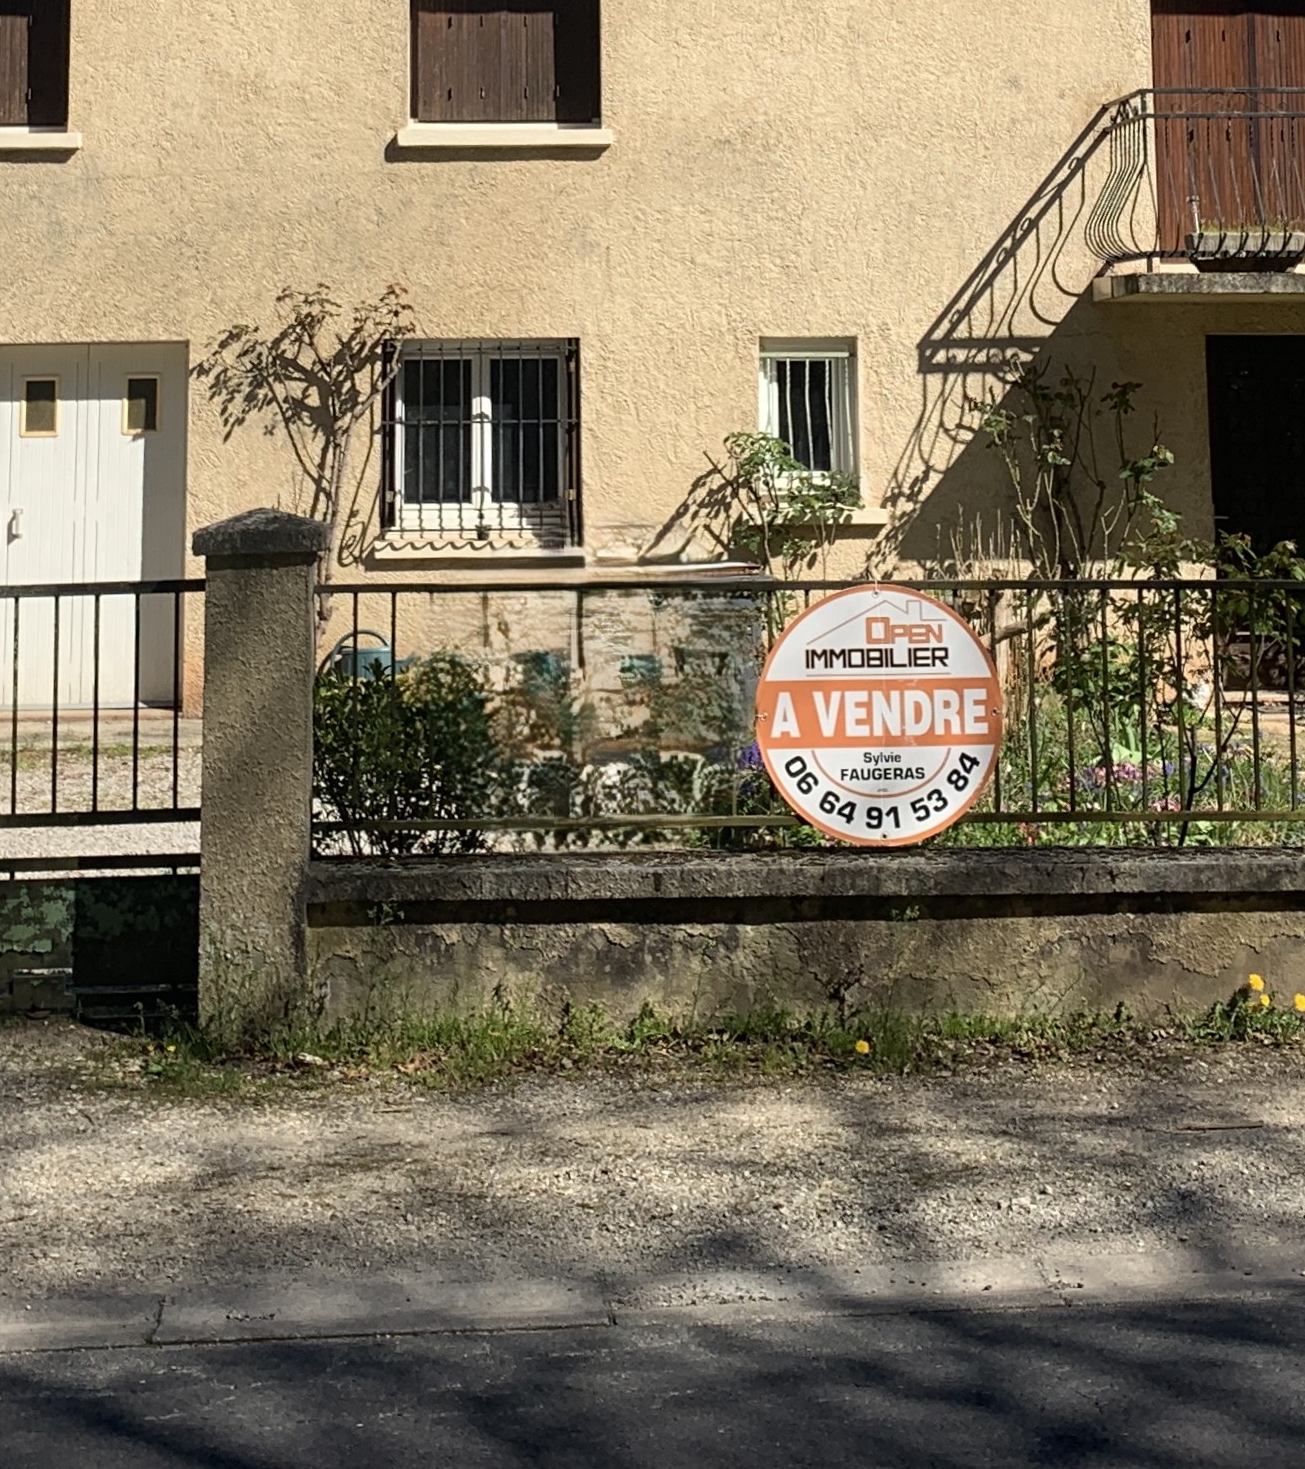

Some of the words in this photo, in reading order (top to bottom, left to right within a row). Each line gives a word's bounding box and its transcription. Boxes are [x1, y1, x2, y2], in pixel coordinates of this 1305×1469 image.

[865, 616, 943, 644] OPEN
[805, 647, 949, 669] IMMOBILIER
[770, 691, 801, 738] A
[812, 688, 989, 737] VENDRE
[863, 752, 902, 765] Sylvie
[840, 767, 925, 781] FAUGERAS
[784, 755, 819, 795] 06
[818, 790, 858, 824] 64
[865, 806, 901, 829] 91
[910, 788, 949, 822] 53
[947, 752, 981, 792] 84
